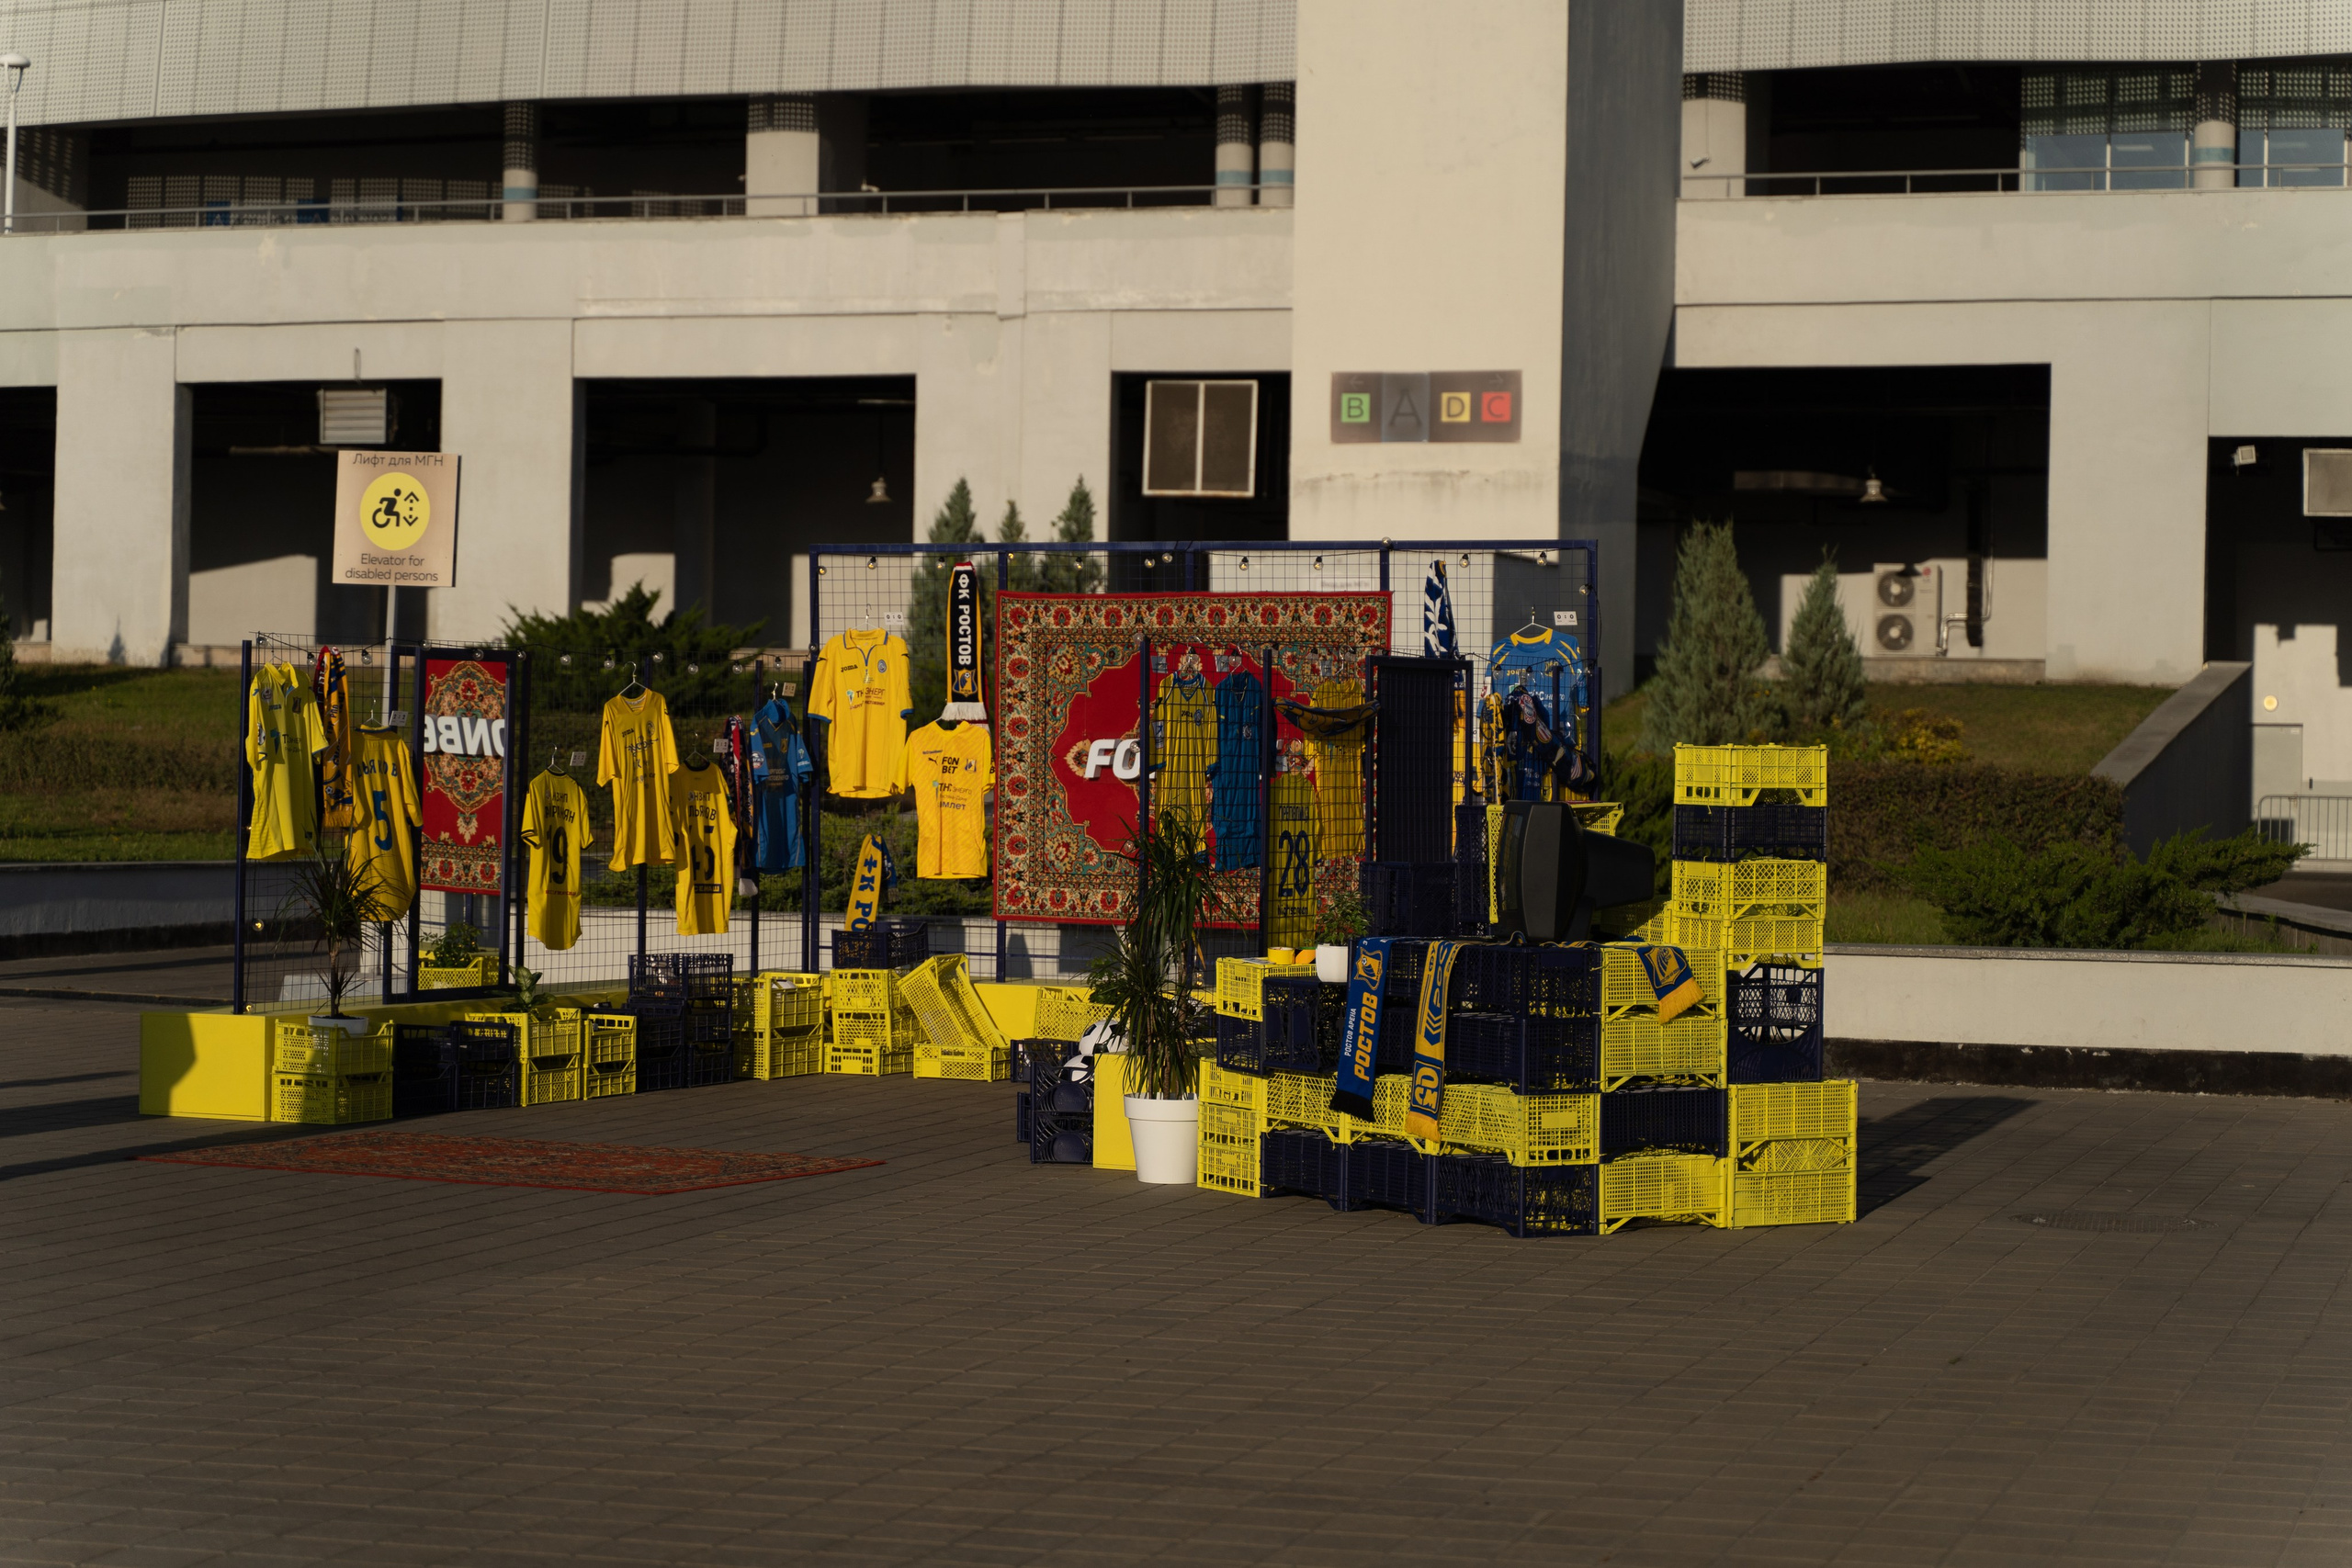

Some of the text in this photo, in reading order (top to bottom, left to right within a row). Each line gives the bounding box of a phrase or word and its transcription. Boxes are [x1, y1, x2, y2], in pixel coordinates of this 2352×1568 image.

[1347, 388, 1506, 427] B A D C
[353, 453, 444, 468] Лифт для МГН
[345, 568, 439, 583] disabled persons
[360, 553, 425, 567] Elevator for
[958, 573, 972, 666] ФК РОСТОВ
[856, 687, 886, 698] ТН ЭНЕРГ
[942, 756, 960, 765] FON
[942, 765, 958, 773] BET
[373, 790, 393, 852] 5
[547, 825, 569, 886] 19
[858, 854, 878, 892] ФК
[1278, 829, 1310, 897] 28
[1344, 1008, 1357, 1057] РОСТОВ АРЕНА
[1354, 991, 1379, 1082] РОСТОВ
